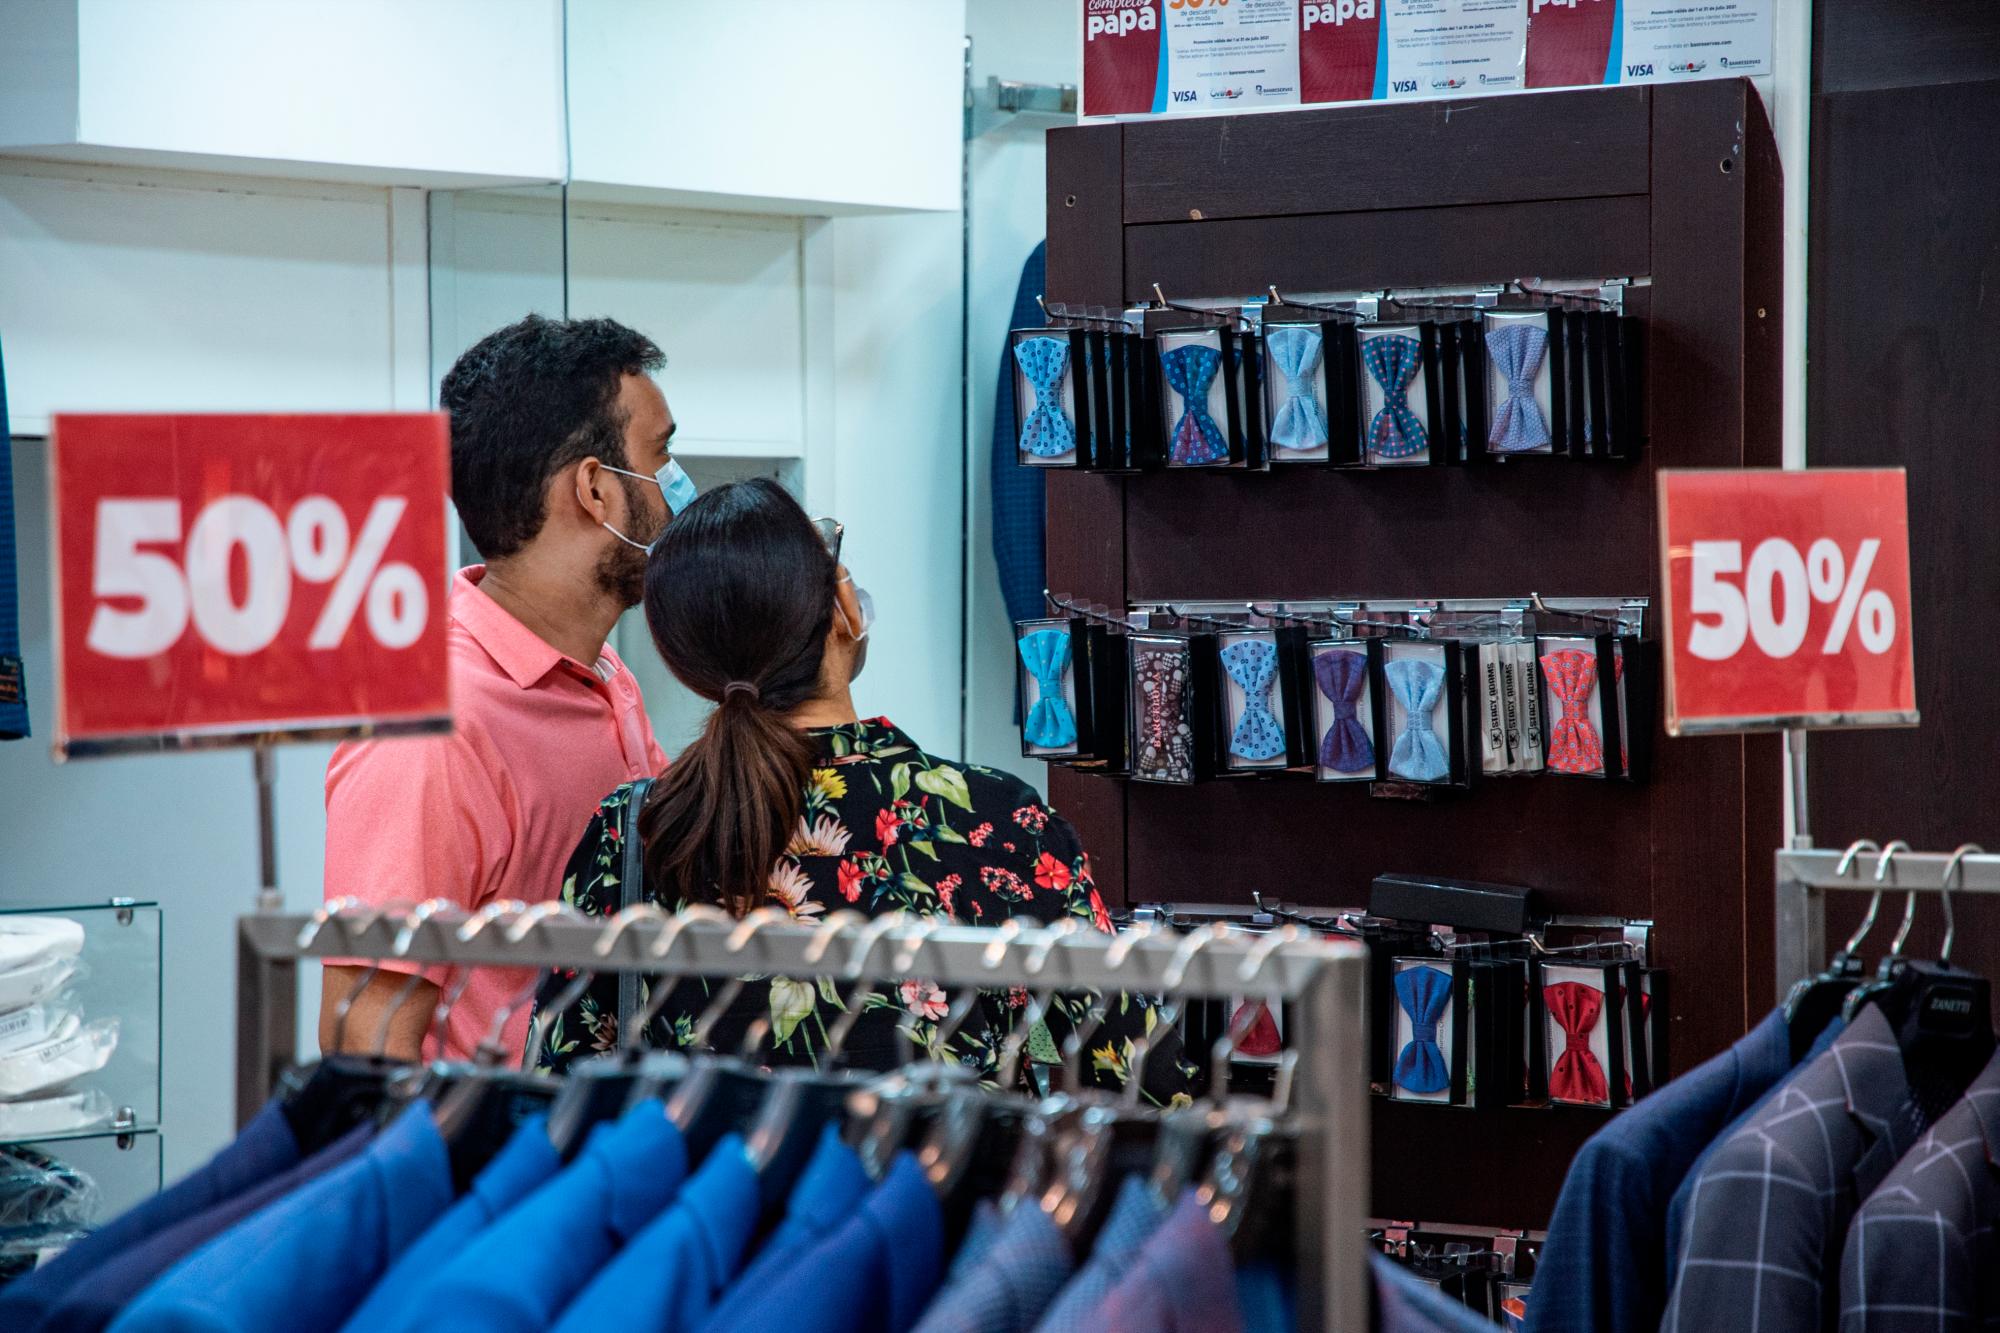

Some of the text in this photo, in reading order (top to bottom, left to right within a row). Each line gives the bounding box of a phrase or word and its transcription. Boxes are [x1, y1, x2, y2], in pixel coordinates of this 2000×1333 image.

[1172, 90, 1197, 102] VISA
[1392, 80, 1418, 92] VISA
[1627, 64, 1654, 76] VISA
[87, 495, 428, 658] 50%
[1688, 537, 1896, 660] 50%
[1487, 662, 1499, 728] STACY ADAMS
[1505, 663, 1517, 729] STACY ADAMS
[1527, 662, 1537, 728] STACY ADAMS
